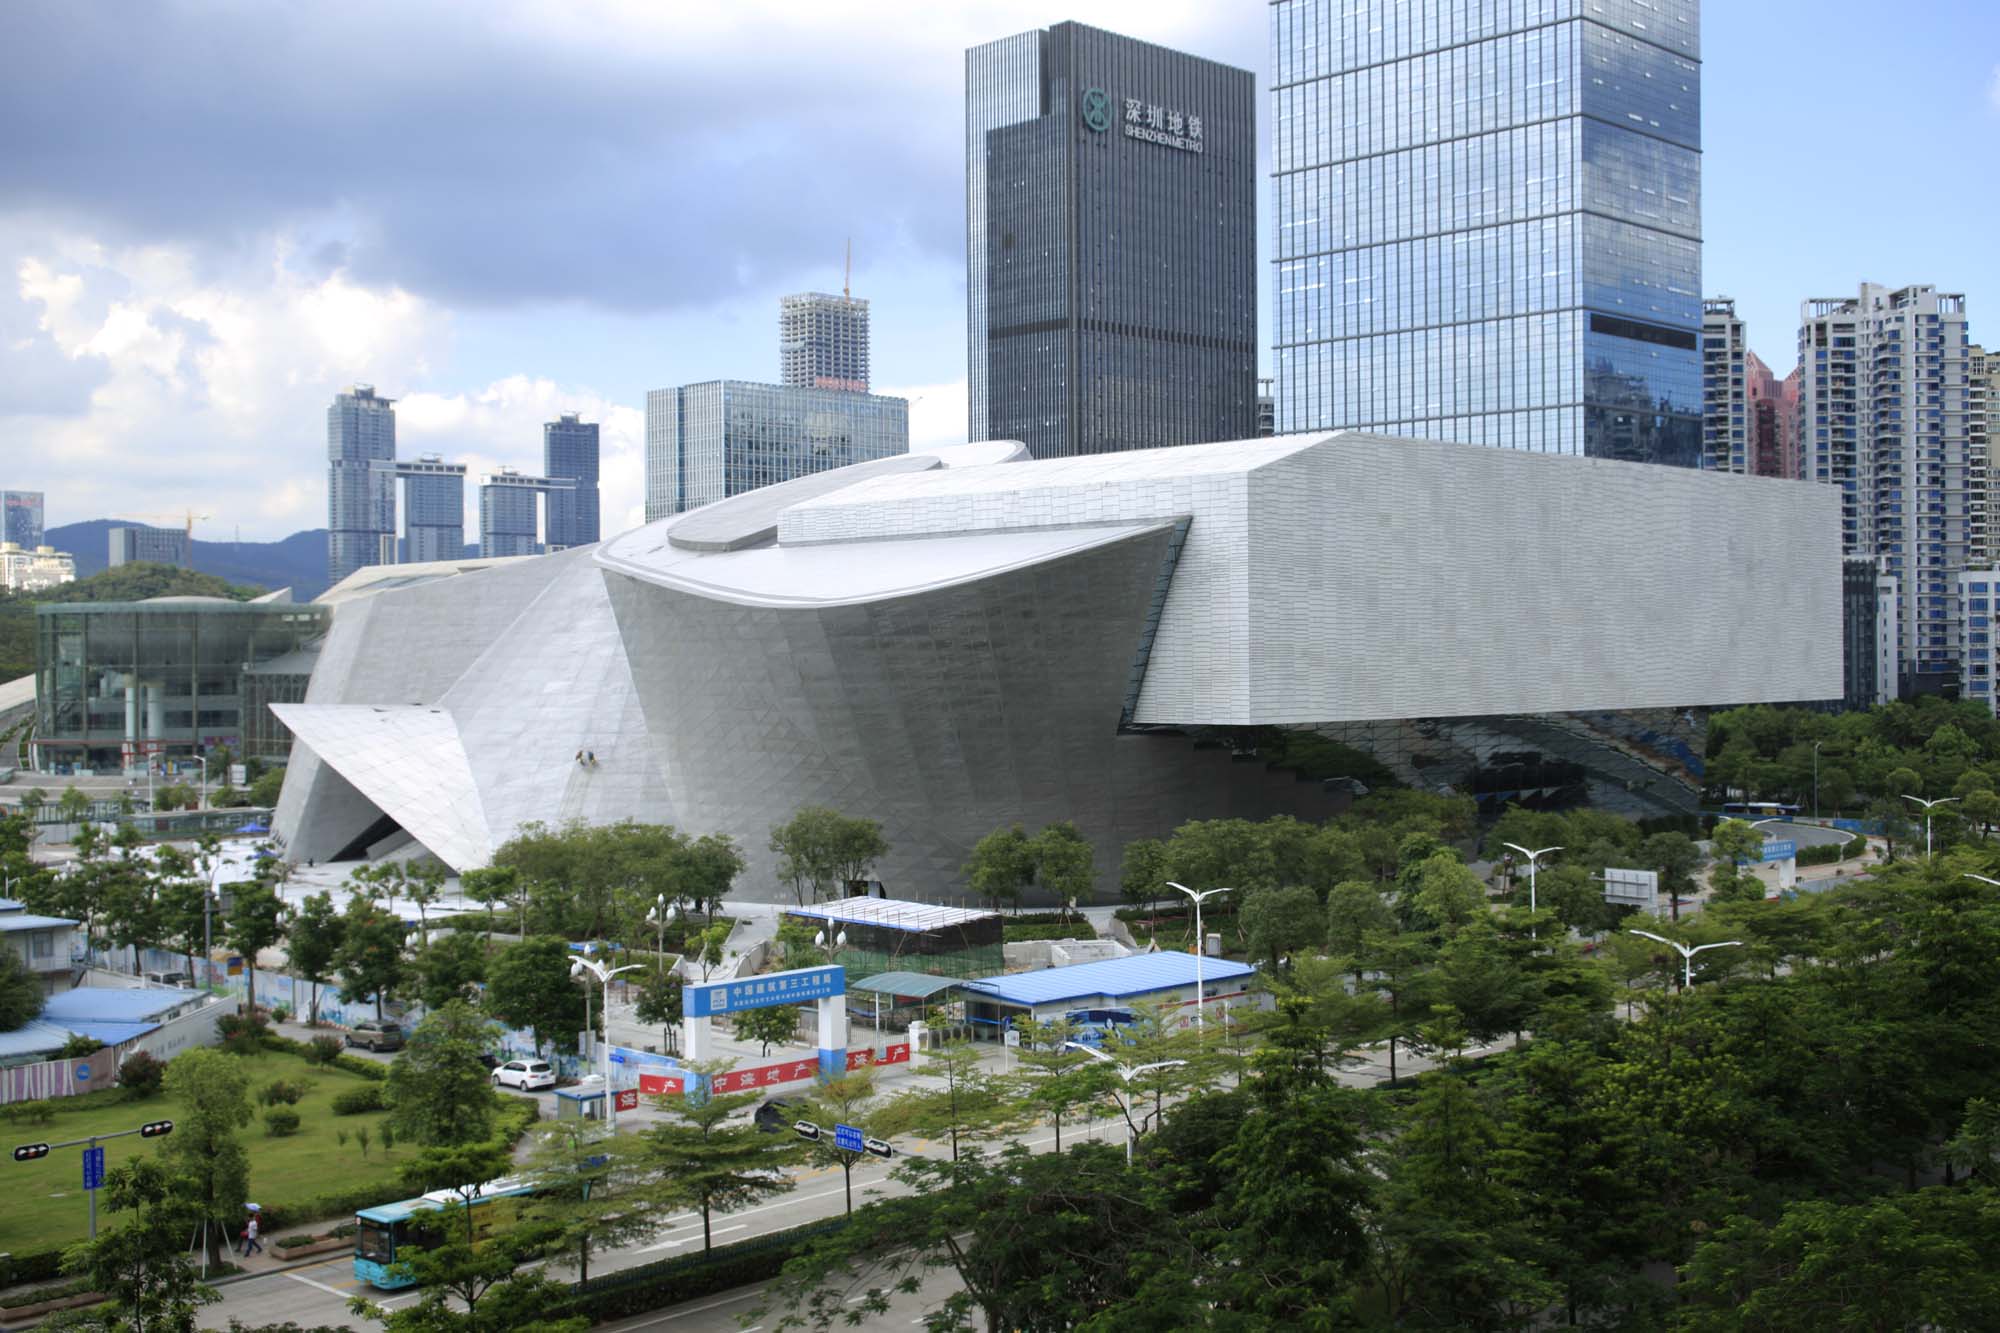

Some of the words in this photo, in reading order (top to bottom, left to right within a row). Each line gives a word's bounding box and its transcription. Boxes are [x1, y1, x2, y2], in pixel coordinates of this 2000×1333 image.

[1125, 97, 1203, 139] 深圳地铁
[1125, 123, 1171, 146] SHENZHEN
[1171, 136, 1203, 153] METRO
